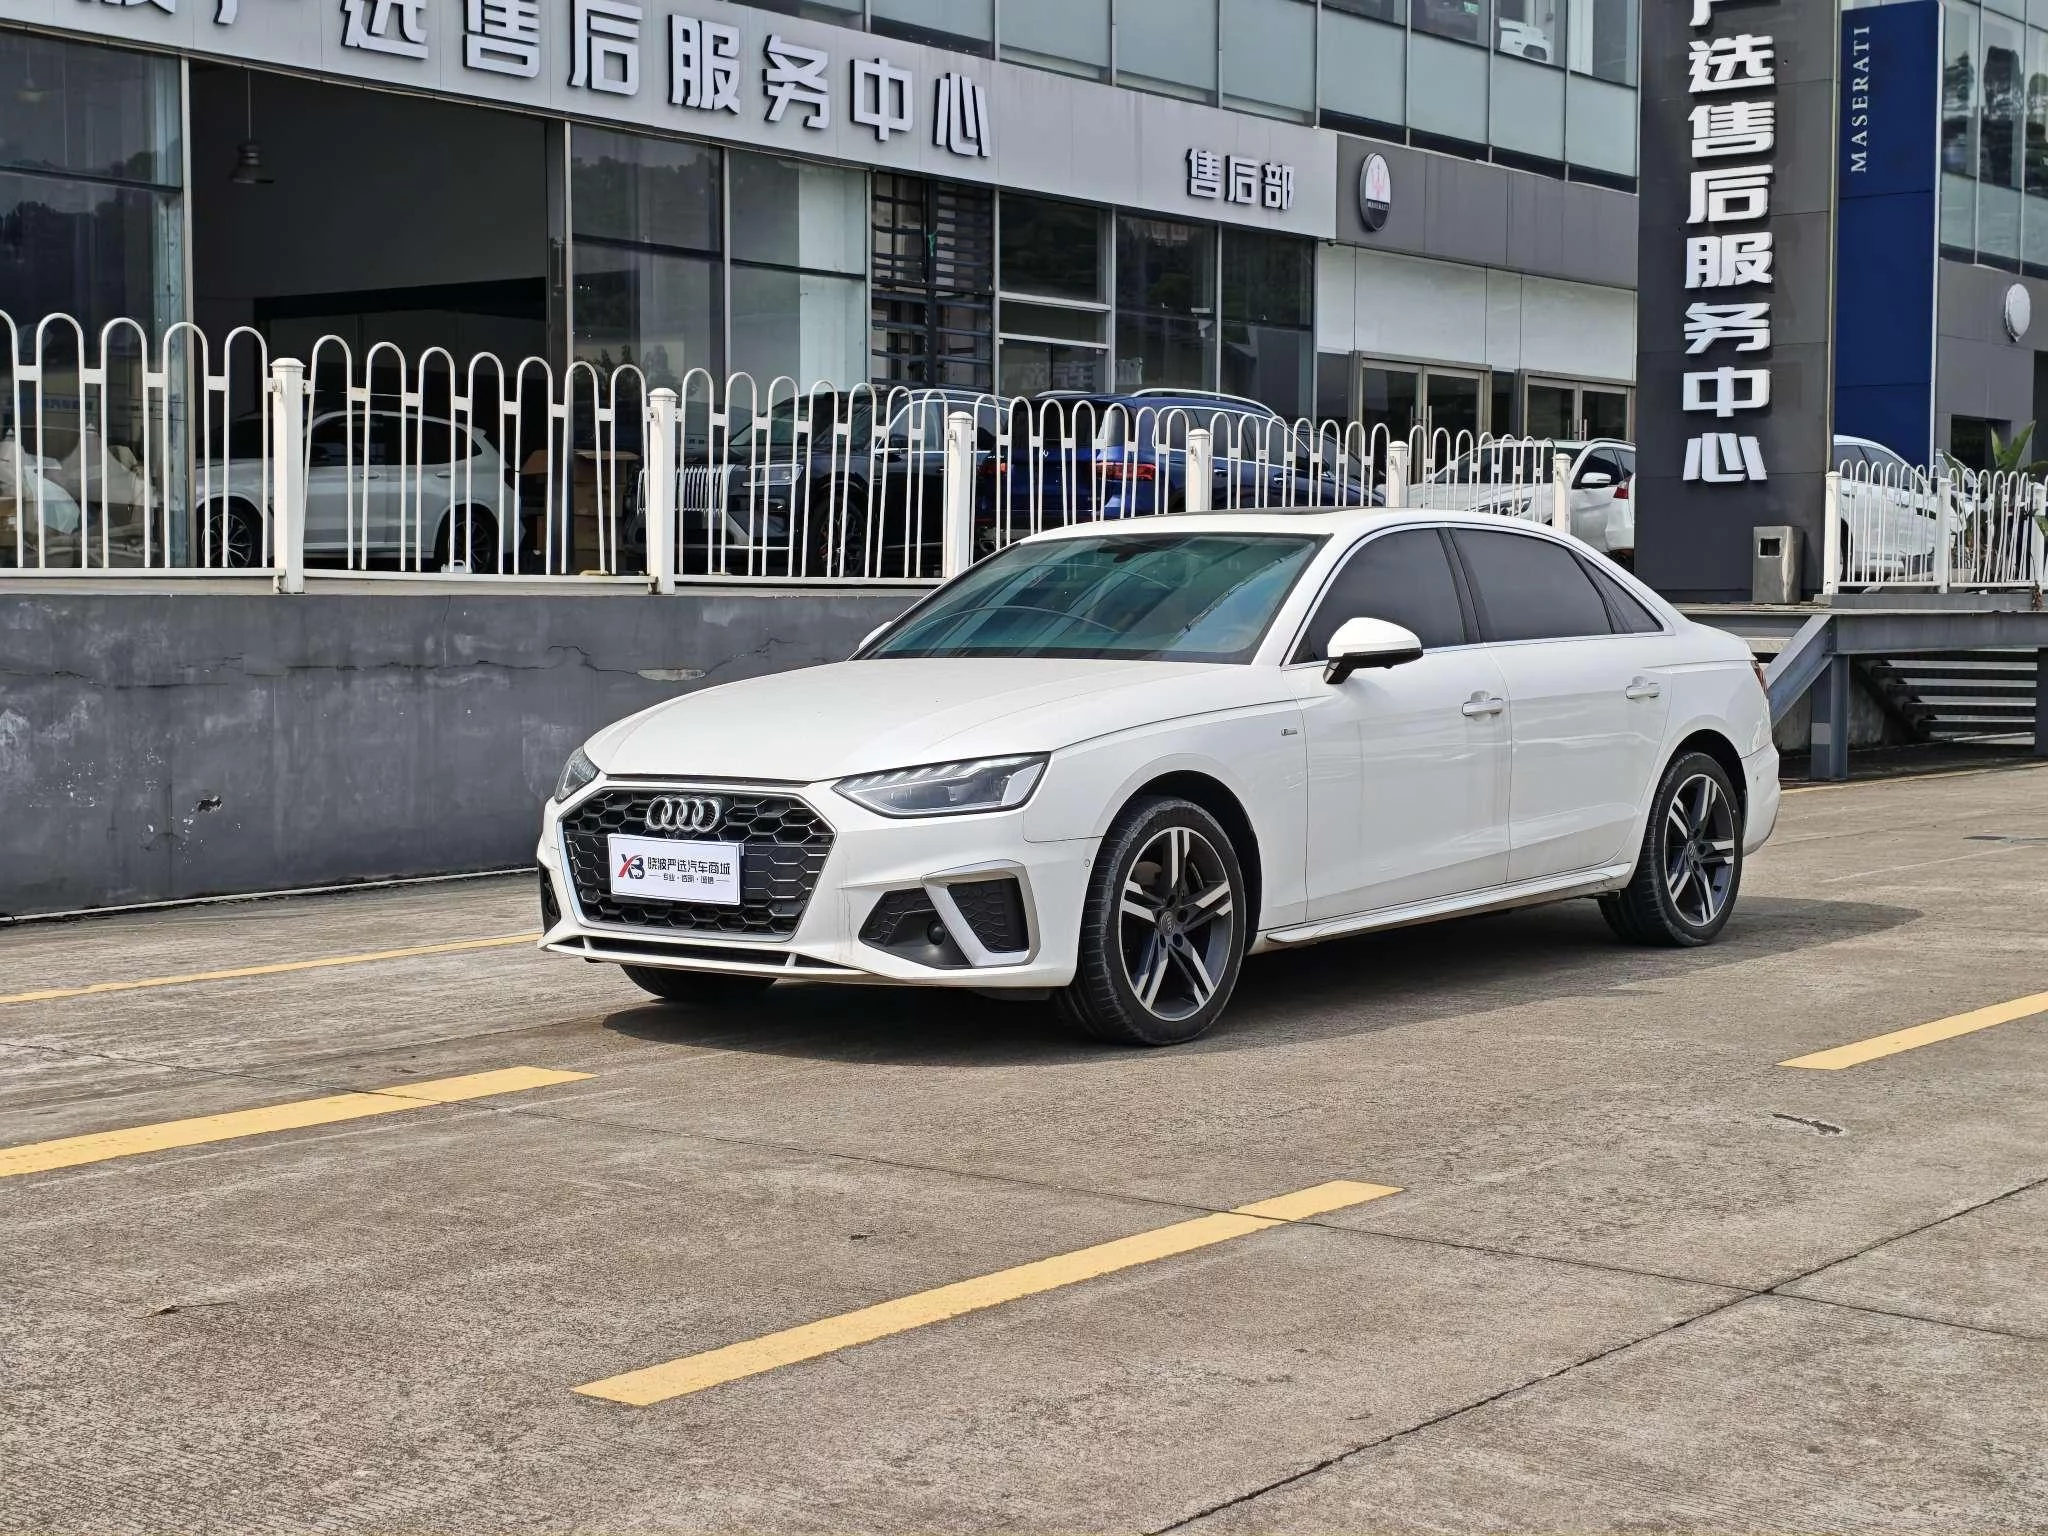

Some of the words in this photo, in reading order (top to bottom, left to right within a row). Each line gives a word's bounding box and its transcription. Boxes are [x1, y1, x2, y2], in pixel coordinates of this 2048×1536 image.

[103, 0, 991, 157] 选售后服务中心
[1851, 26, 1870, 173] MASERATI
[1185, 148, 1295, 211] 售后部
[647, 856, 731, 875] 晓波严选汽车商城
